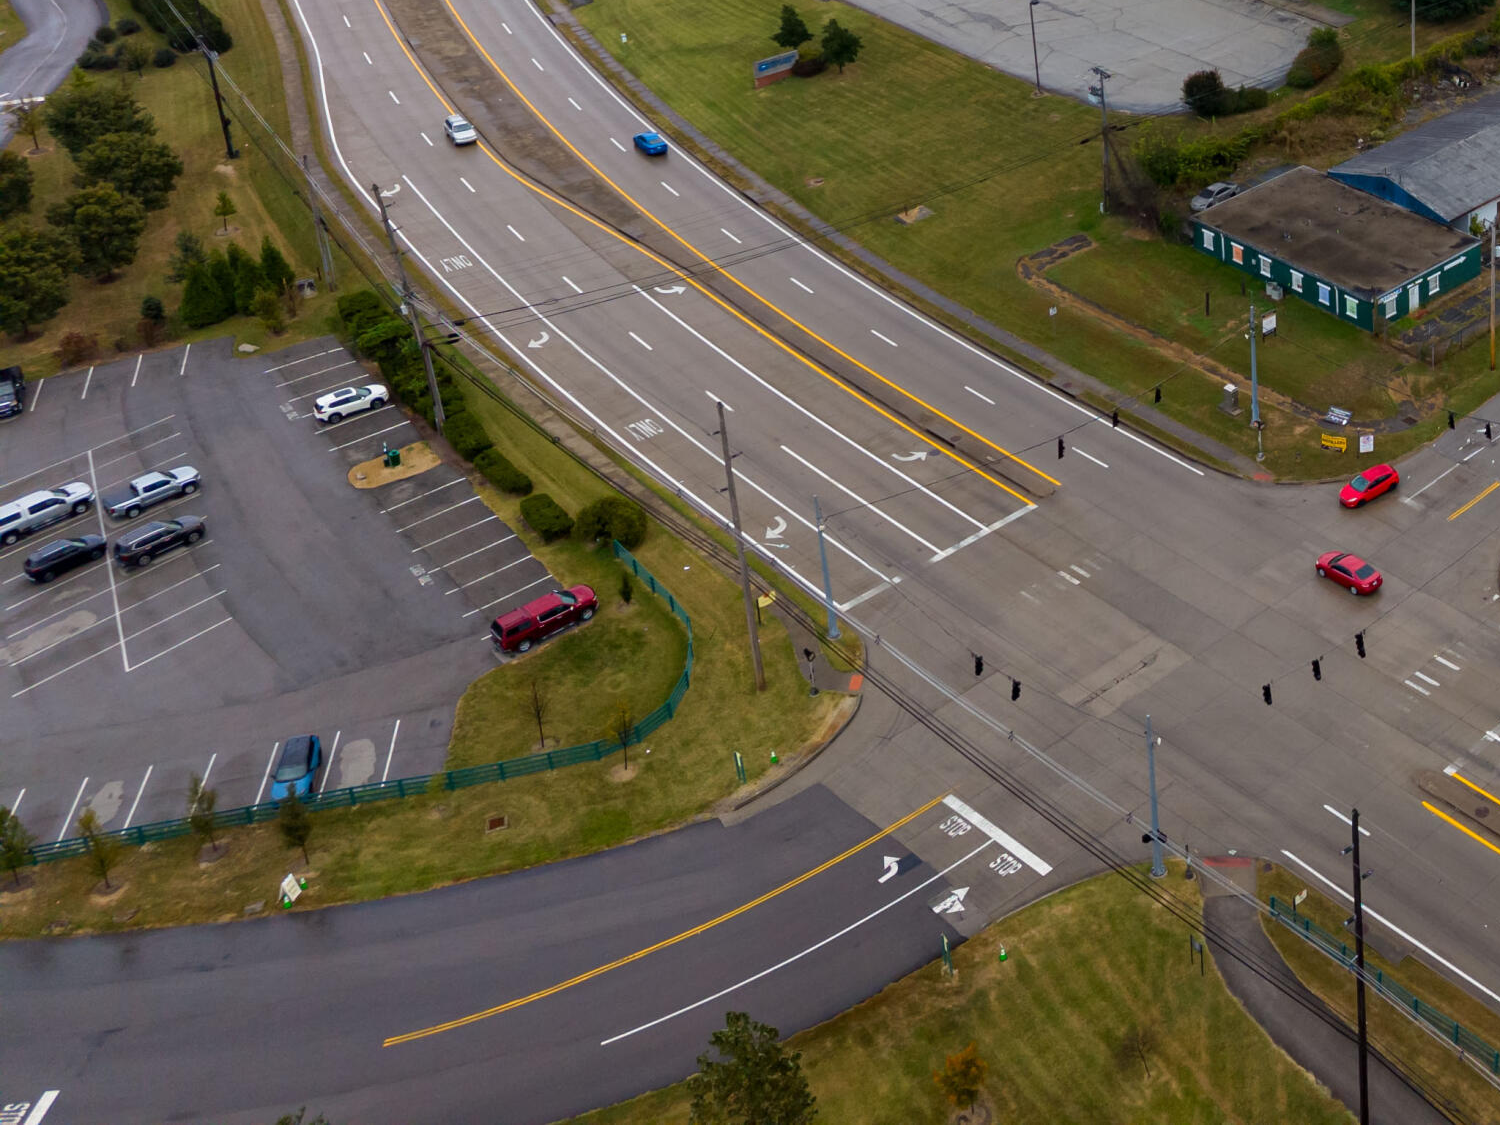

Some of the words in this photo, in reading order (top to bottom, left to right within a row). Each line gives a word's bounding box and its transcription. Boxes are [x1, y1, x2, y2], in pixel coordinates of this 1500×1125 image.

[440, 255, 473, 273] ONLY
[624, 418, 664, 442] ONLY
[939, 815, 972, 838] STOP
[989, 853, 1022, 877] STOP
